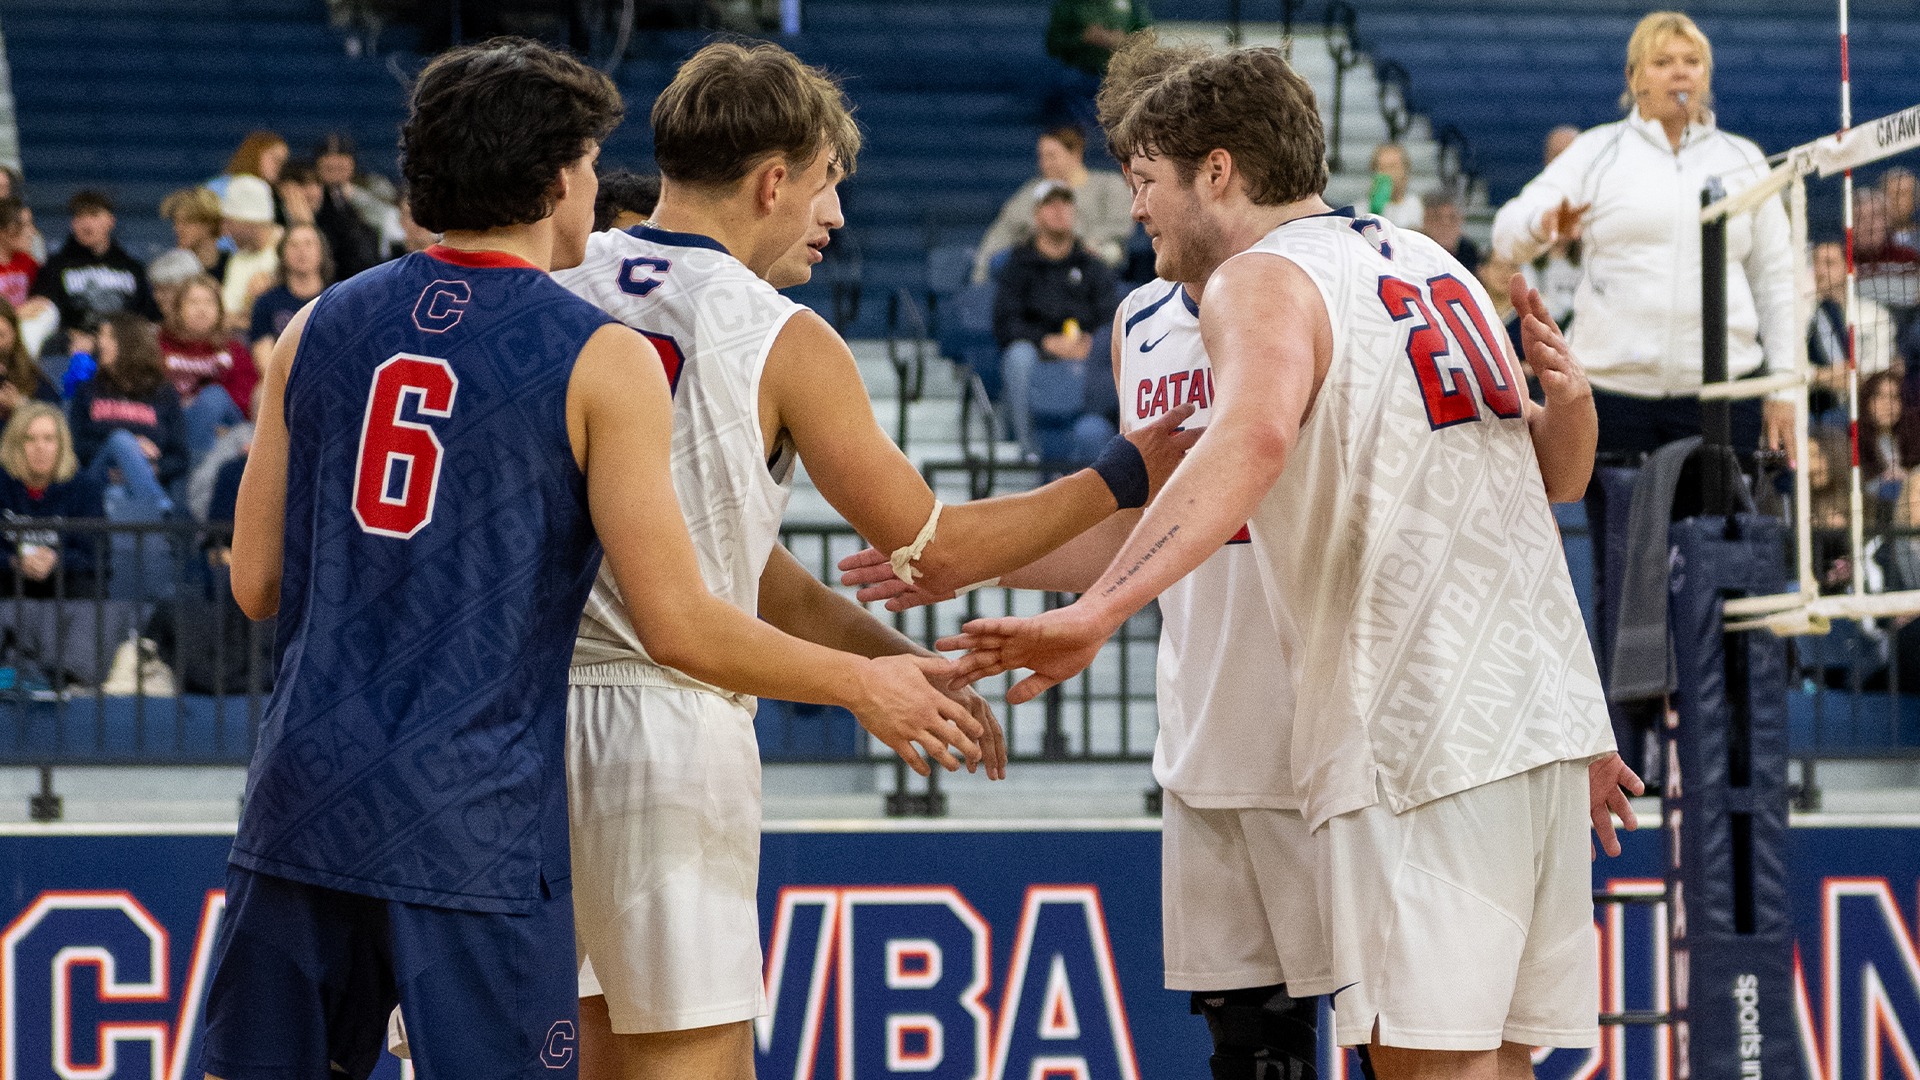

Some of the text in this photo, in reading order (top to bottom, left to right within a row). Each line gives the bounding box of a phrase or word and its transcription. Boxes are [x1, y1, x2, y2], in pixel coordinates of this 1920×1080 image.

[1876, 108, 1920, 147] CATAW
[616, 256, 673, 298] C
[411, 280, 472, 333] C
[1377, 271, 1521, 431] 20
[352, 352, 458, 540] 6
[1734, 974, 1763, 1058] sports
[540, 1020, 575, 1069] C
